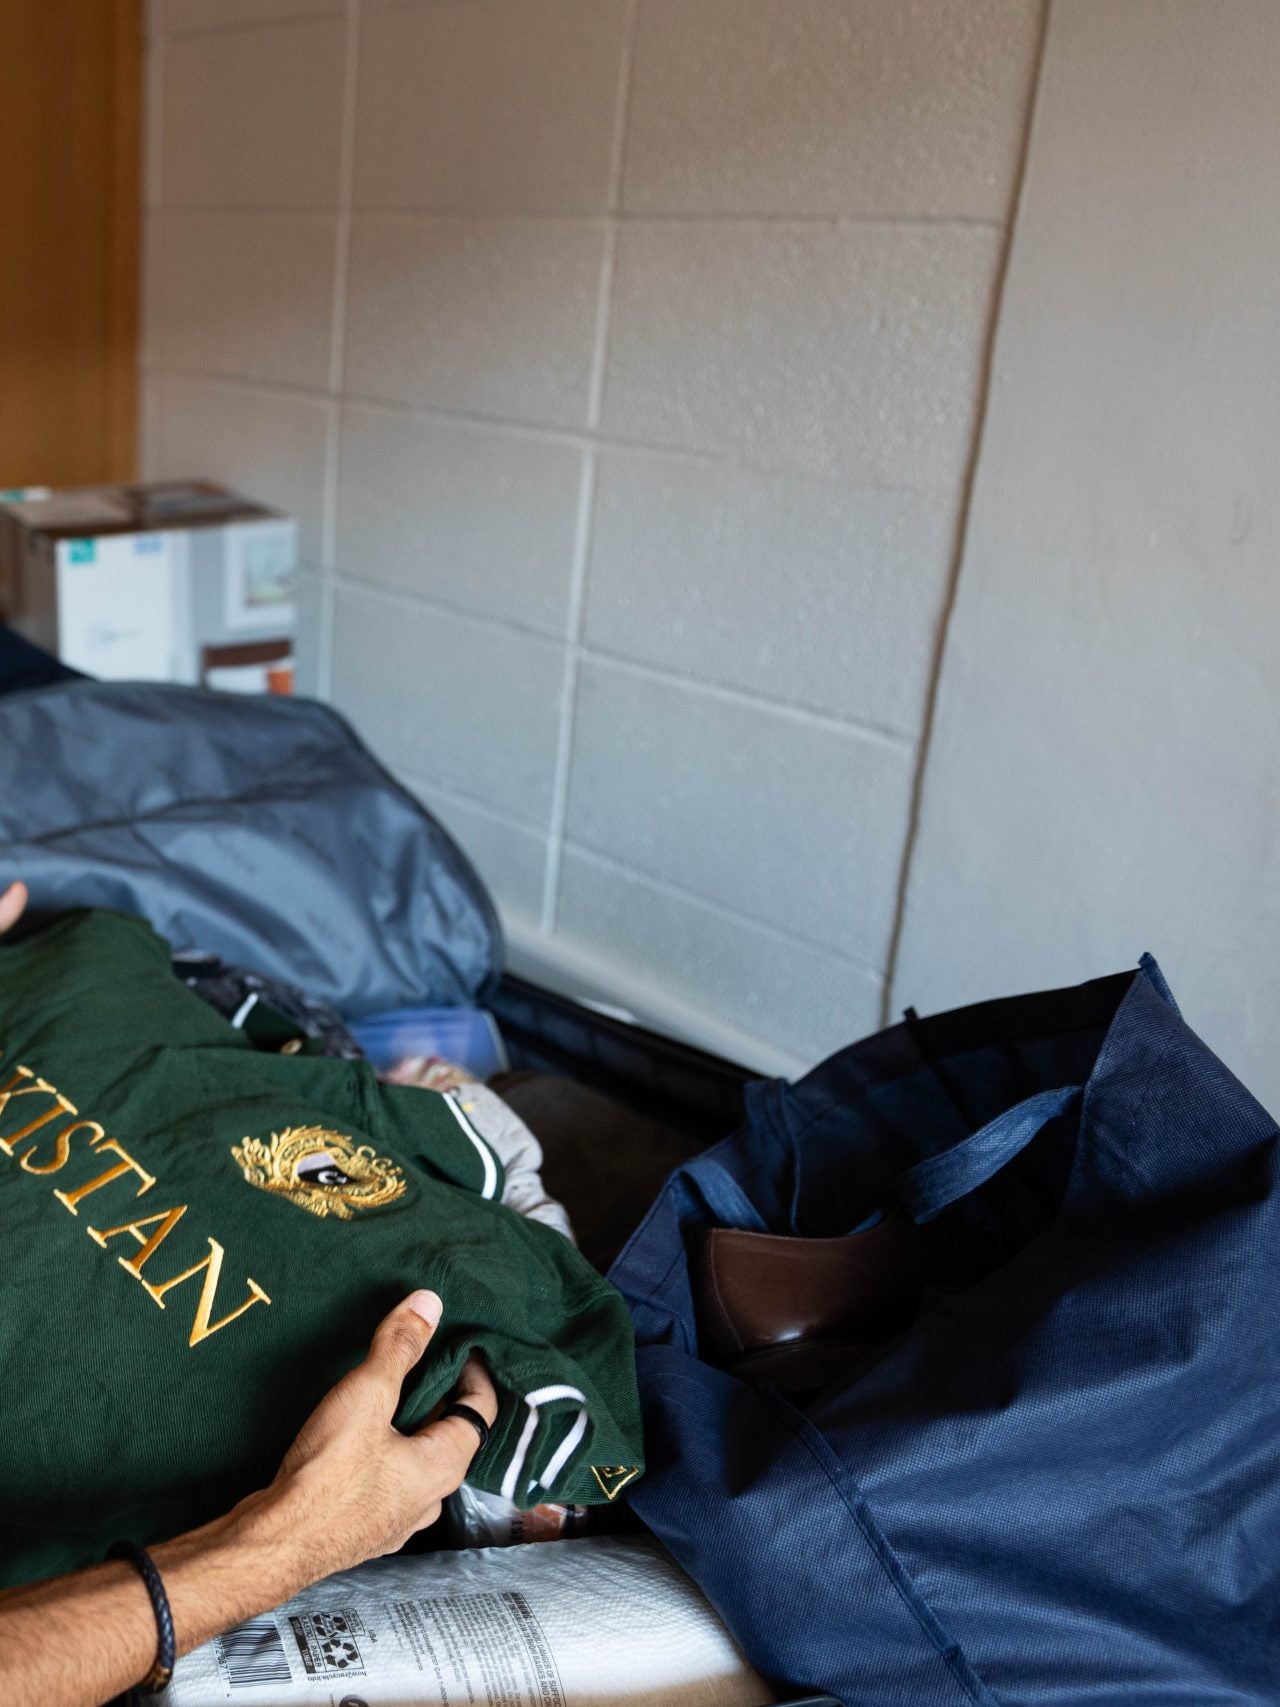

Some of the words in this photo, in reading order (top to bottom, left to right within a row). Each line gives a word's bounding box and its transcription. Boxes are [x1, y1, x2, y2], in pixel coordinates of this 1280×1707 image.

[367, 1629, 377, 1643] USA
[511, 1593, 532, 1619] WARNING:
[536, 1644, 551, 1669] DANGER
[545, 1669, 554, 1678] OF
[301, 1648, 312, 1666] TUBE
[310, 1644, 321, 1667] PAPER
[307, 1671, 366, 1681] how2recycle.info
[524, 1638, 537, 1655] FROM
[531, 1655, 546, 1679] BABIES
[539, 1680, 550, 1695] AND
